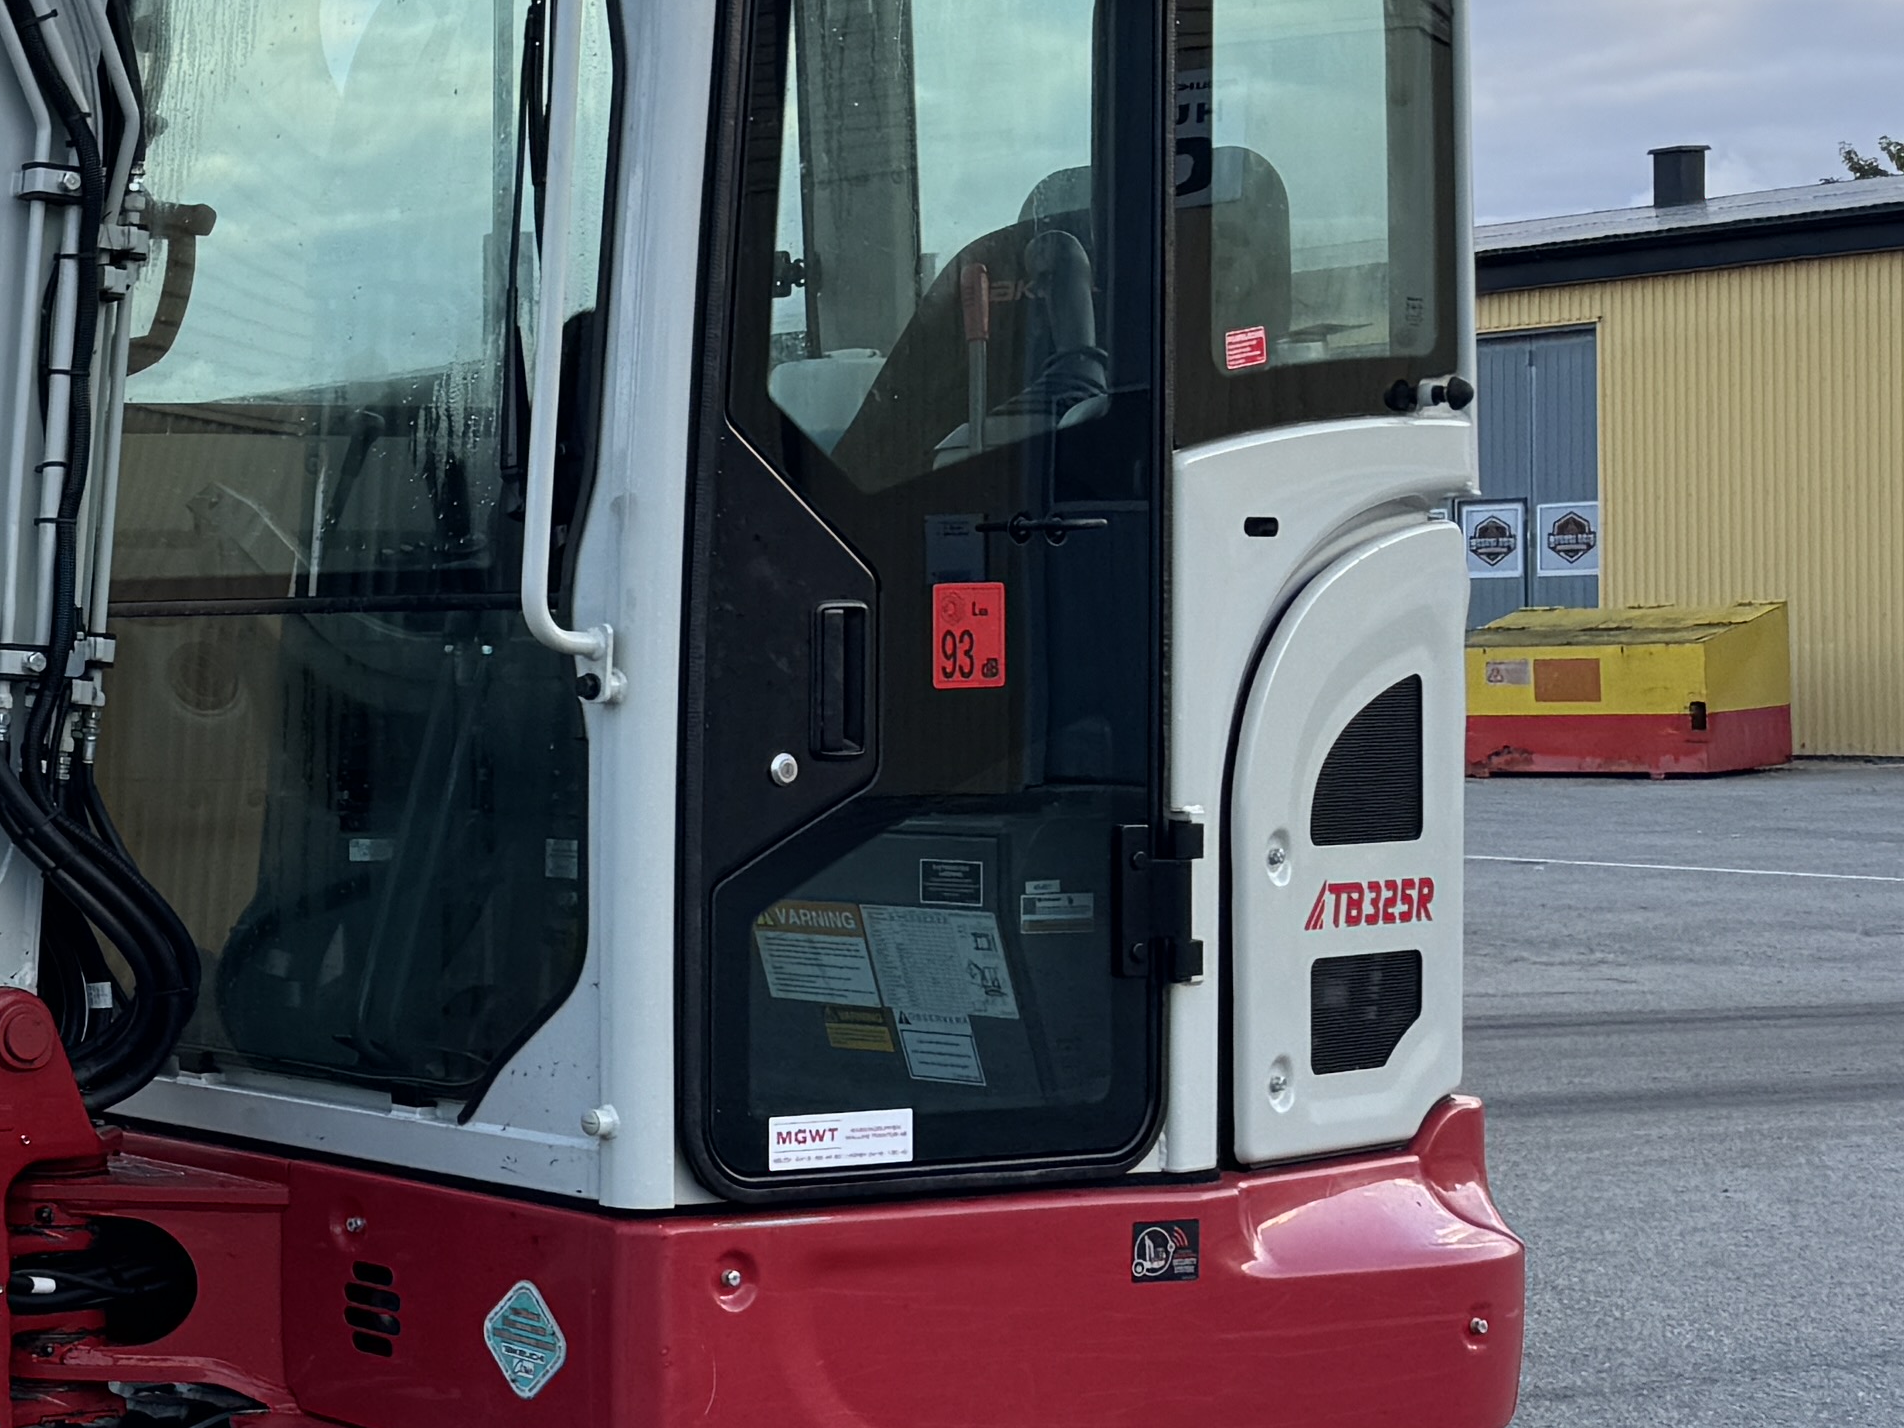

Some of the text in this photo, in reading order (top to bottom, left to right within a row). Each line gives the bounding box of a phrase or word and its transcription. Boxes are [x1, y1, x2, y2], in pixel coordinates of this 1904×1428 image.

[941, 629, 975, 679] 93
[775, 907, 856, 931] VARNING
[1327, 876, 1435, 928] TB325R
[776, 1127, 839, 1146] MGWT
